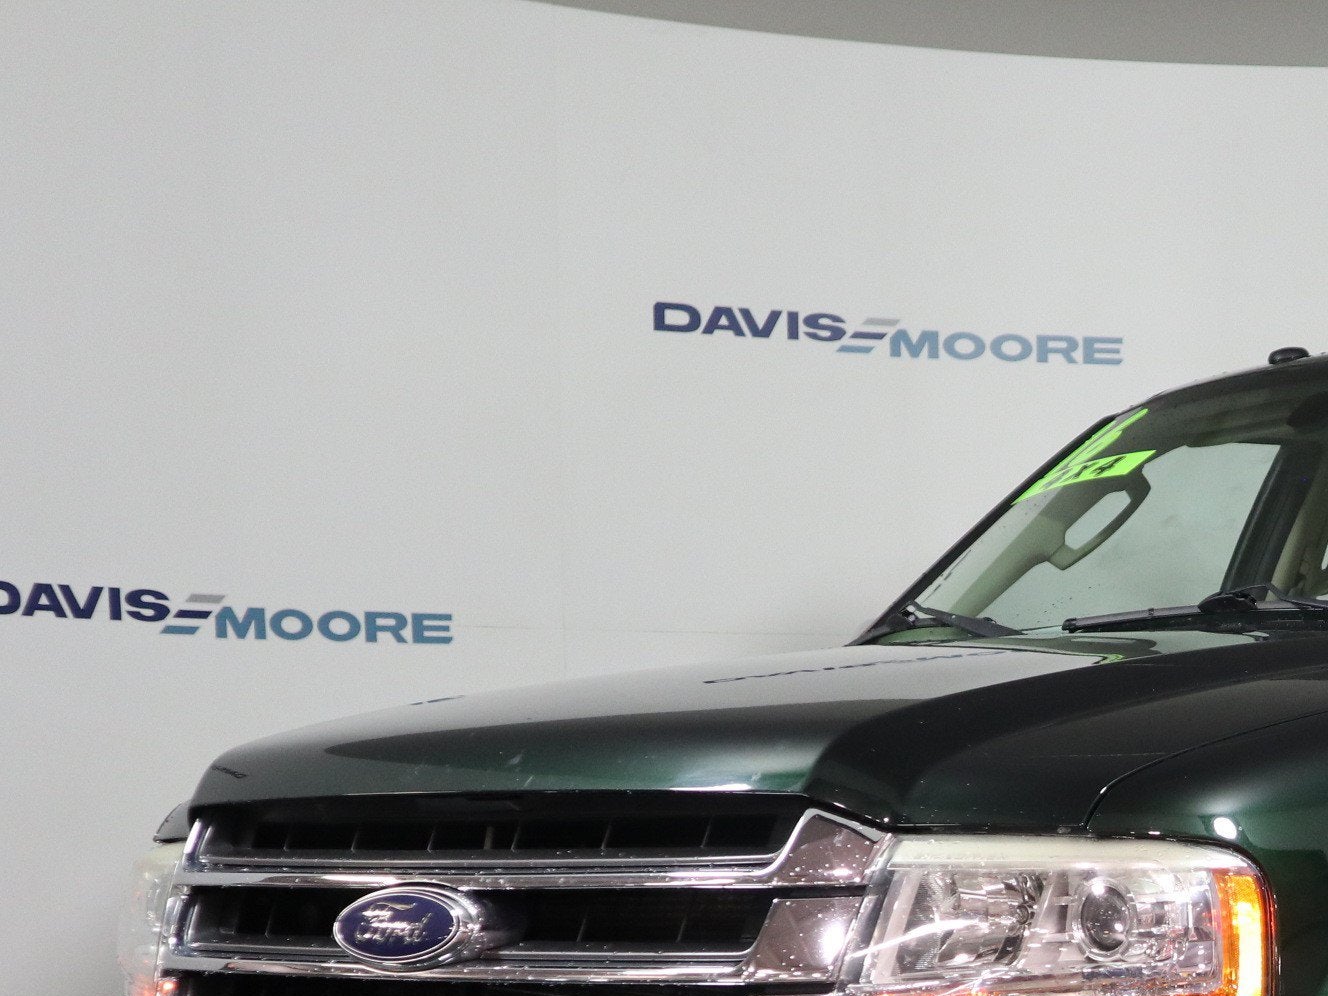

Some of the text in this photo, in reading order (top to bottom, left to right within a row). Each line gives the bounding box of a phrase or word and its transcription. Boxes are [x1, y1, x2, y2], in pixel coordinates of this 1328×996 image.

[652, 301, 1124, 366] DAVIS MOORE
[214, 605, 455, 646] MOORE
[354, 901, 432, 944] Ford
